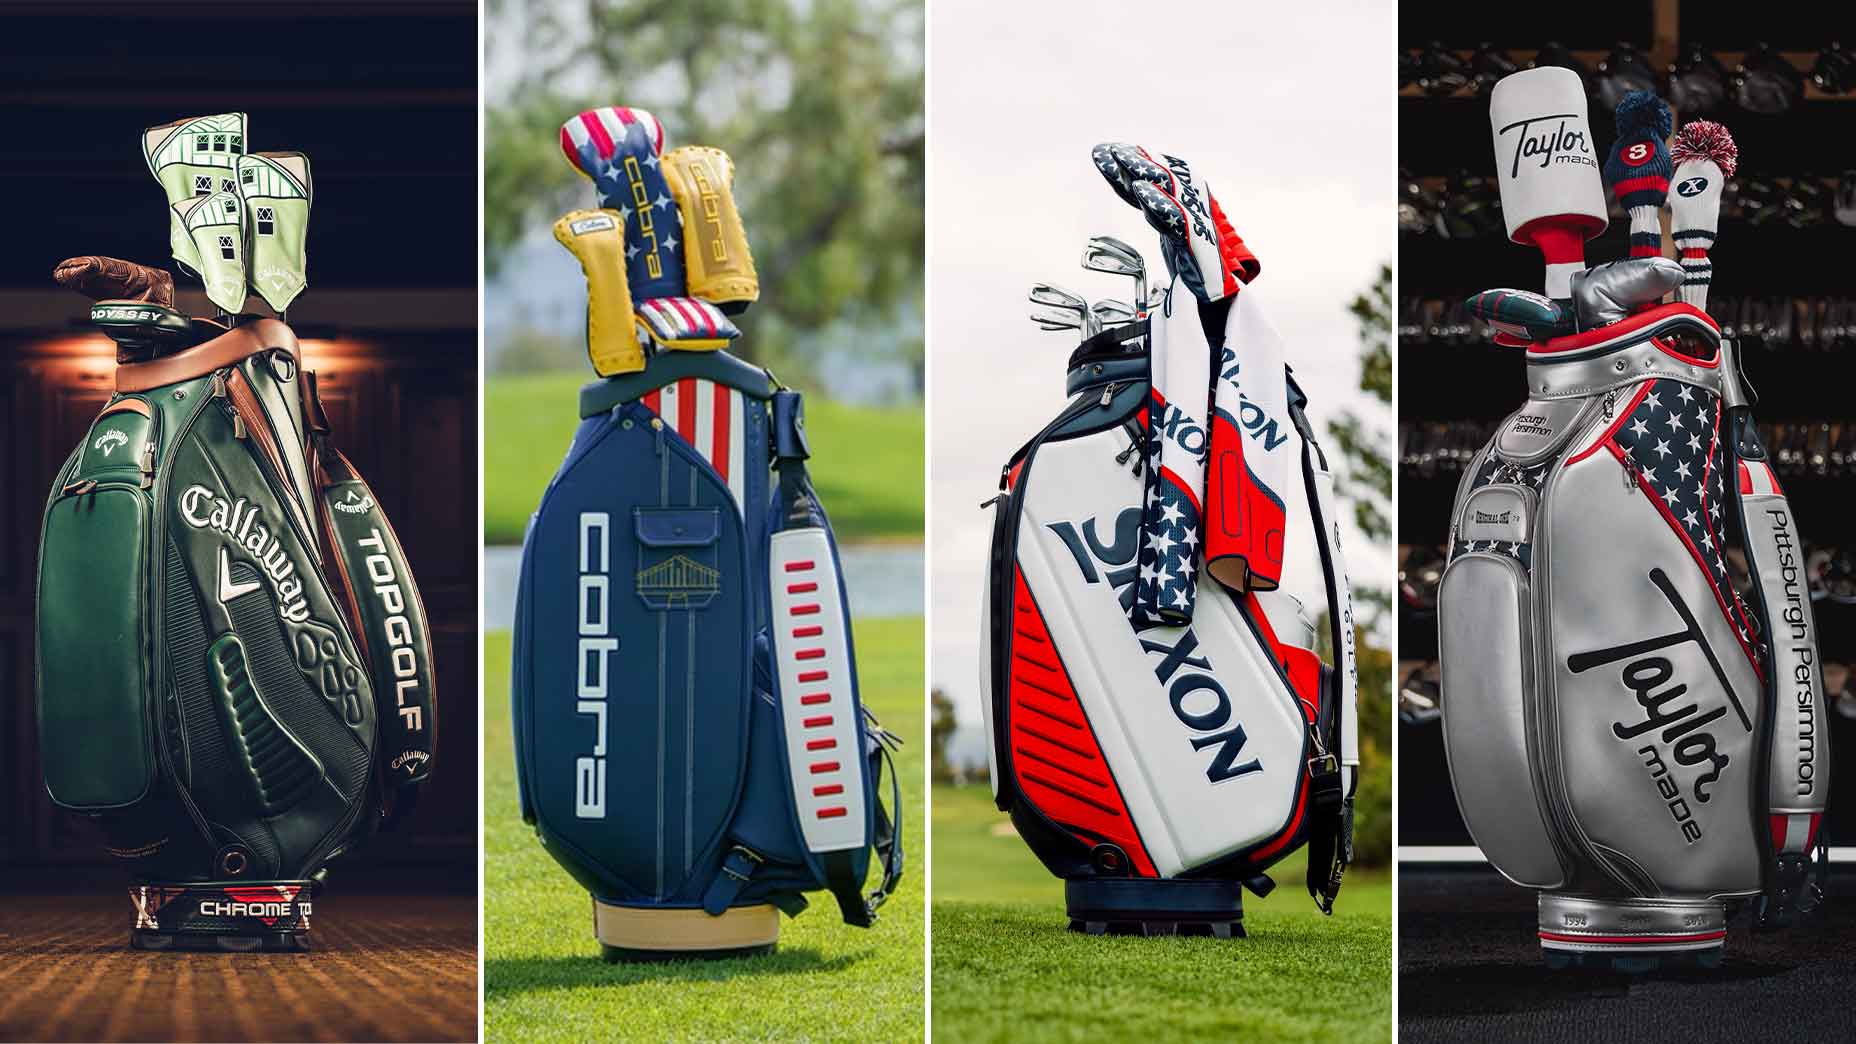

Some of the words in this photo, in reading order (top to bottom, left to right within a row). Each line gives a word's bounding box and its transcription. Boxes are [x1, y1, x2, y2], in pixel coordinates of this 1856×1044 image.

[1499, 114, 1589, 178] Taylor
[1555, 154, 1599, 169] made
[1628, 143, 1648, 160] 3
[1680, 178, 1709, 195] X
[624, 156, 663, 279] cobra
[689, 163, 728, 263] cobra
[95, 429, 129, 449] Callaway
[181, 485, 311, 623] Callaway
[334, 495, 375, 515] Callaway
[358, 528, 422, 732] TOPGOLF
[576, 513, 619, 818] cobra
[1046, 508, 1264, 784] SXON
[1766, 508, 1808, 640] Pittsburgh
[1792, 646, 1815, 797] Persimmon
[1567, 567, 1753, 802] Taylor
[391, 750, 430, 769] Callaway
[1638, 745, 1702, 843] made
[200, 902, 291, 917] CHROME
